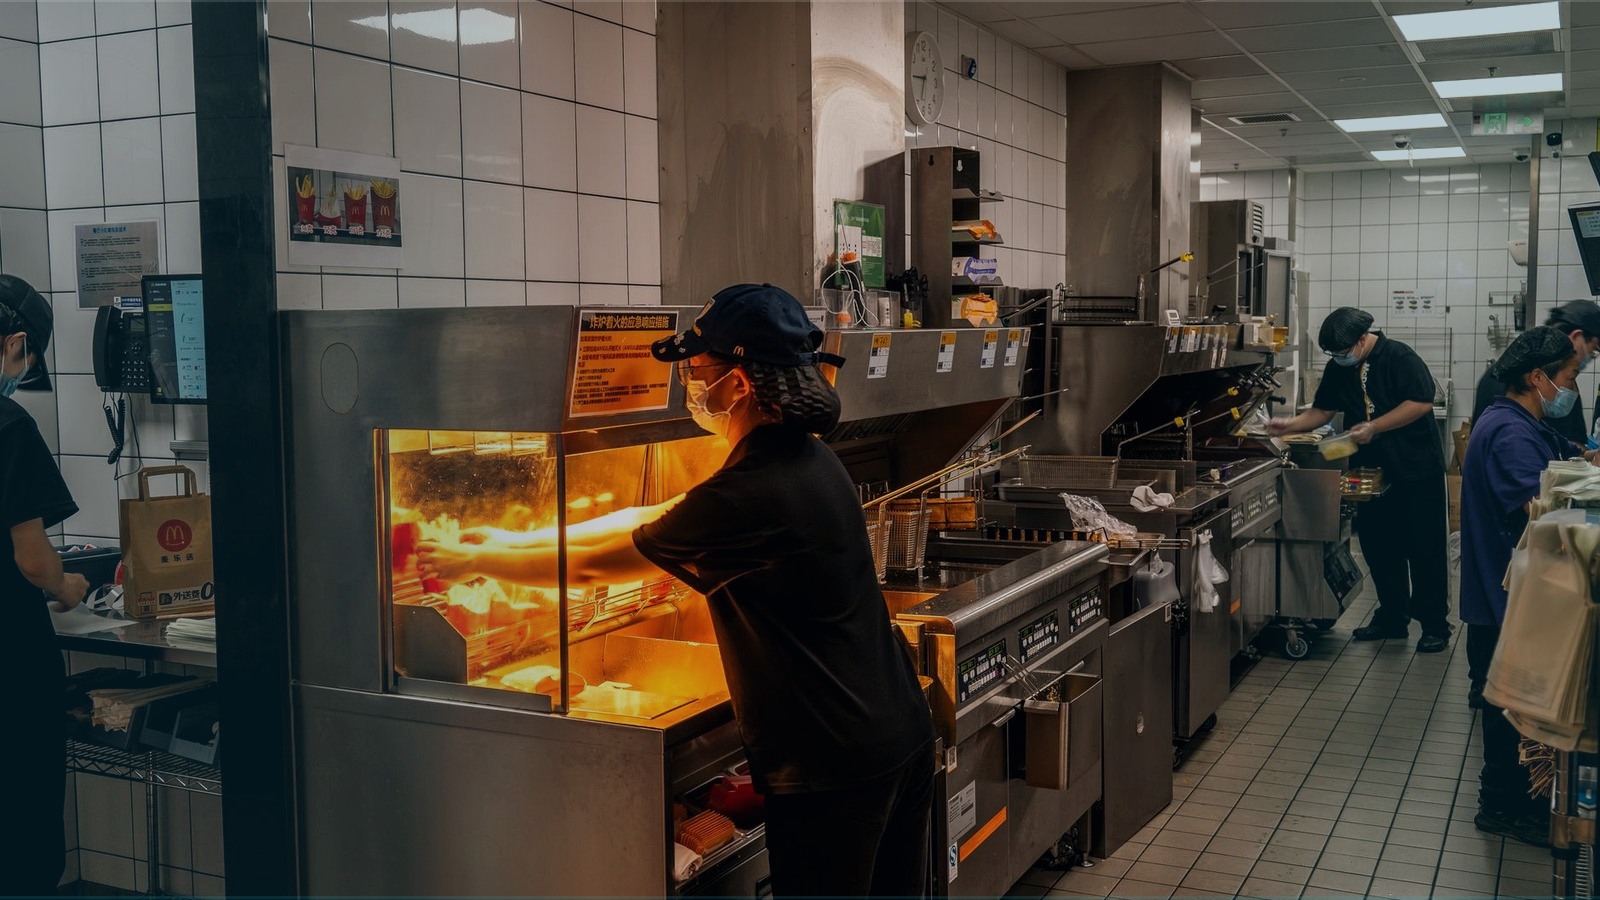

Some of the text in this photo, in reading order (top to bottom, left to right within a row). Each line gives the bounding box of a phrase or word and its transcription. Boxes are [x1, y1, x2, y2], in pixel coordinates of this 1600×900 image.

[920, 40, 926, 51] 12
[931, 60, 936, 72] 2
[933, 78, 938, 89] 3
[927, 104, 932, 115] 5
[589, 314, 670, 330] 炸炉着火的应急响应措施
[160, 554, 195, 564] 麦乐送
